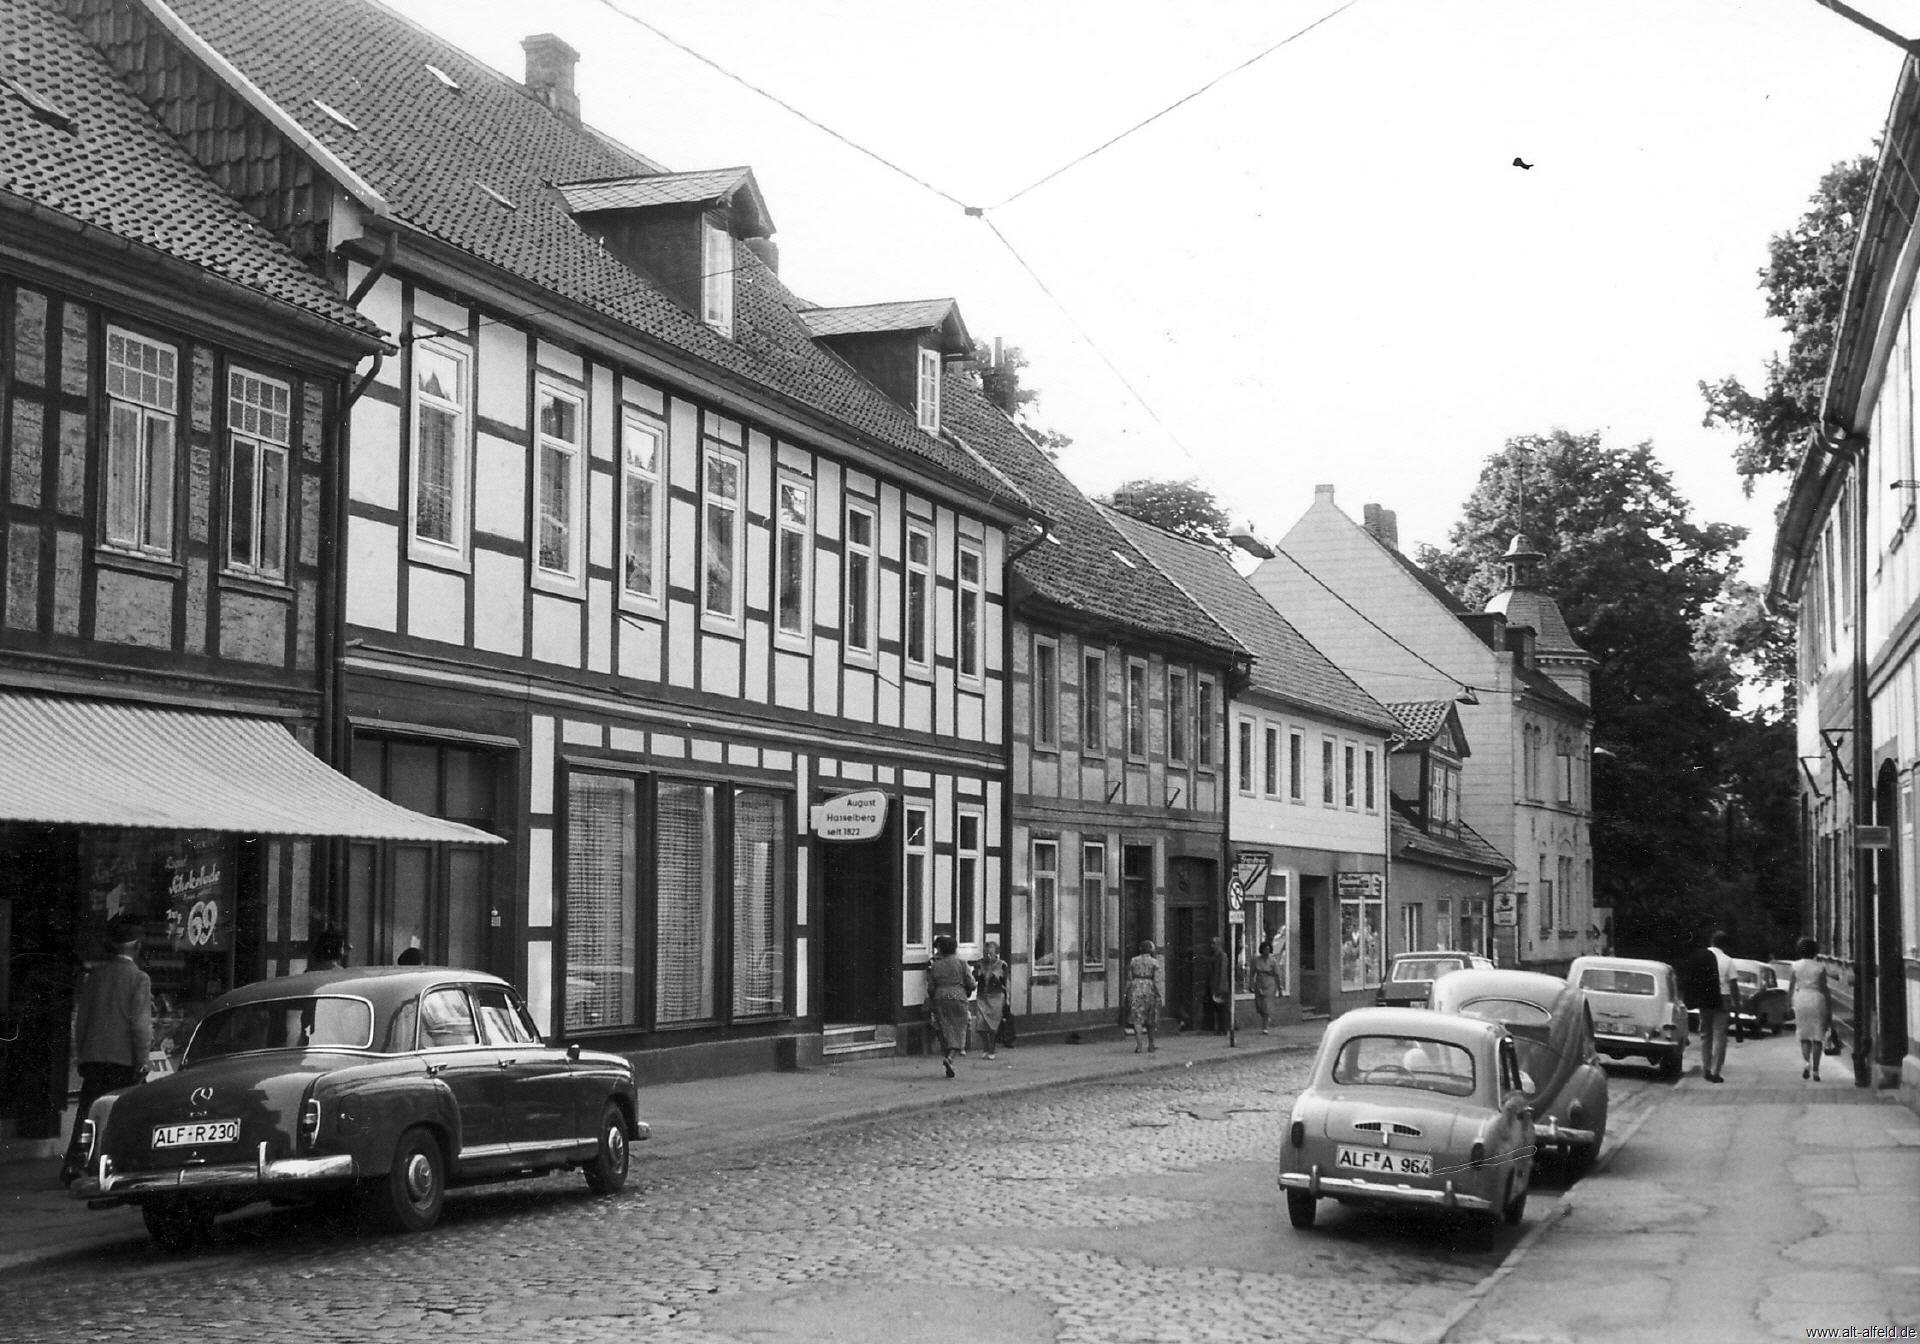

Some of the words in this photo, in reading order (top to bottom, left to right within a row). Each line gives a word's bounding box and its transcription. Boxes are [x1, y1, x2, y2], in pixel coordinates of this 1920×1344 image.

[847, 799, 876, 808] August
[827, 813, 876, 822] Hasselberg
[187, 900, 218, 946] 69
[1400, 1158, 1429, 1175] 964
